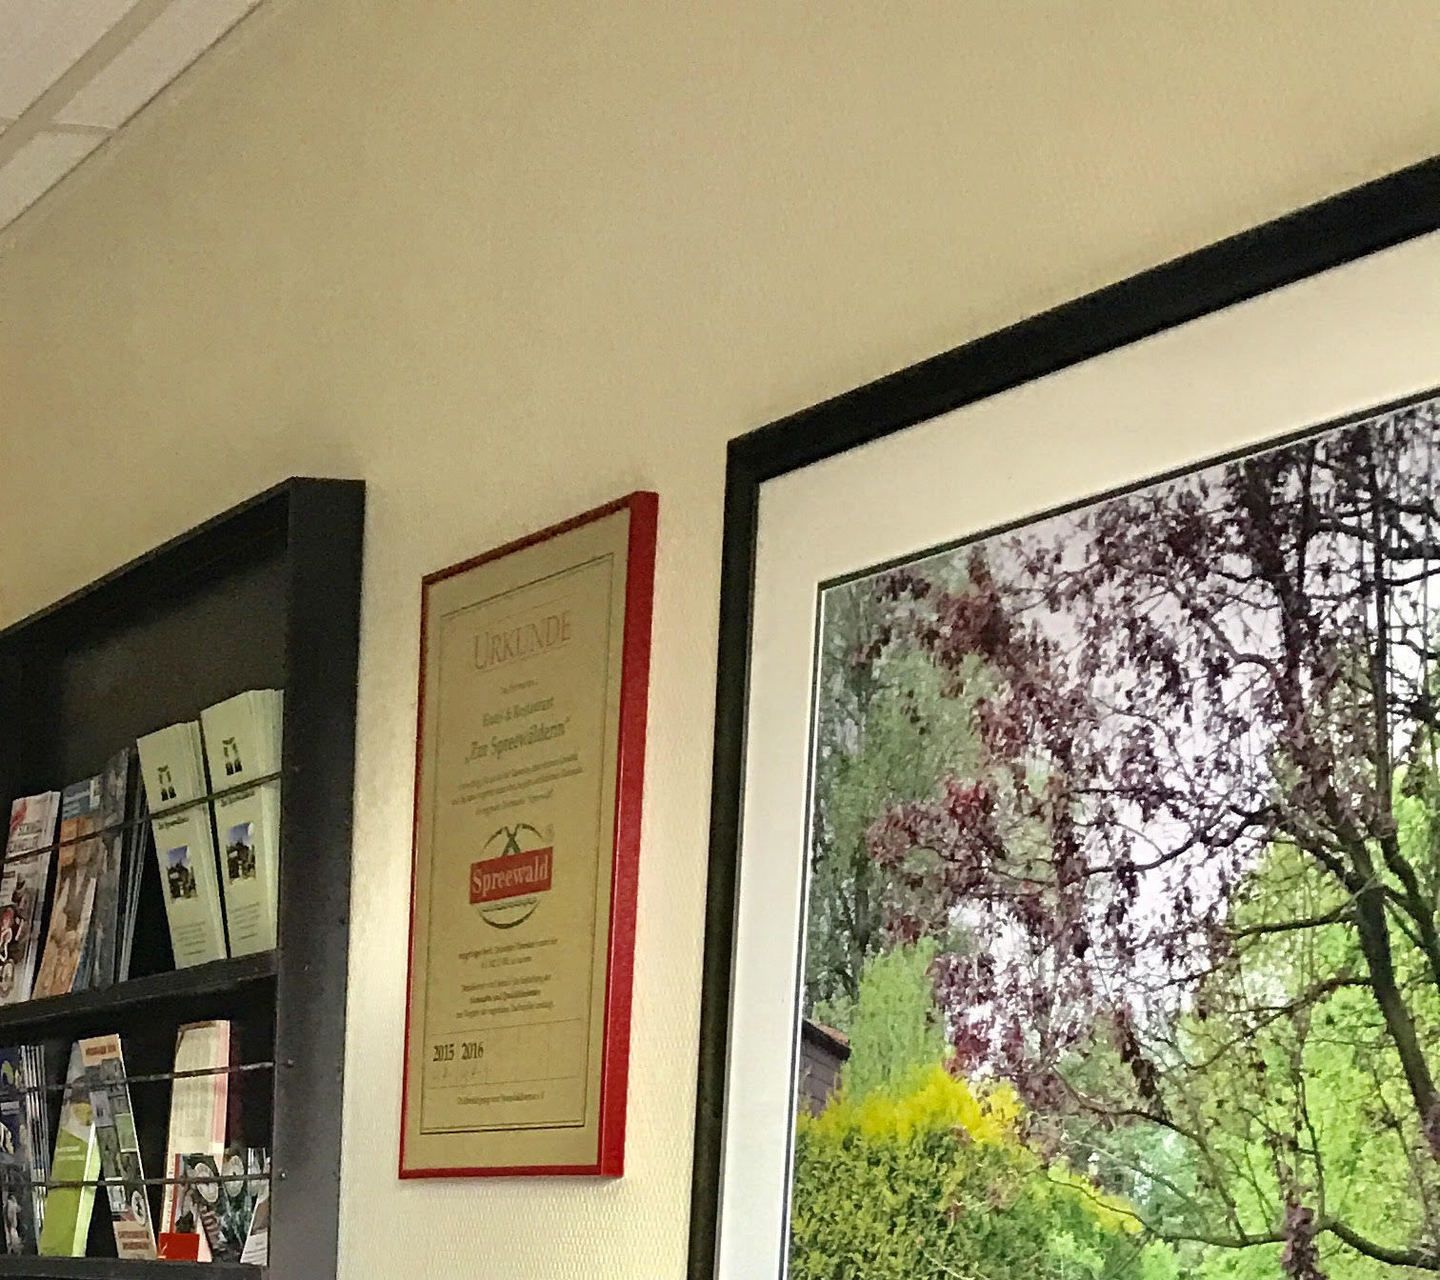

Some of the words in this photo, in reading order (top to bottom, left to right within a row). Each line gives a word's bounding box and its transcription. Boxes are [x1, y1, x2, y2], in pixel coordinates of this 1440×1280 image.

[472, 854, 549, 897] Spreewald
[432, 1043, 455, 1062] 2015
[461, 1041, 484, 1061] 2016
